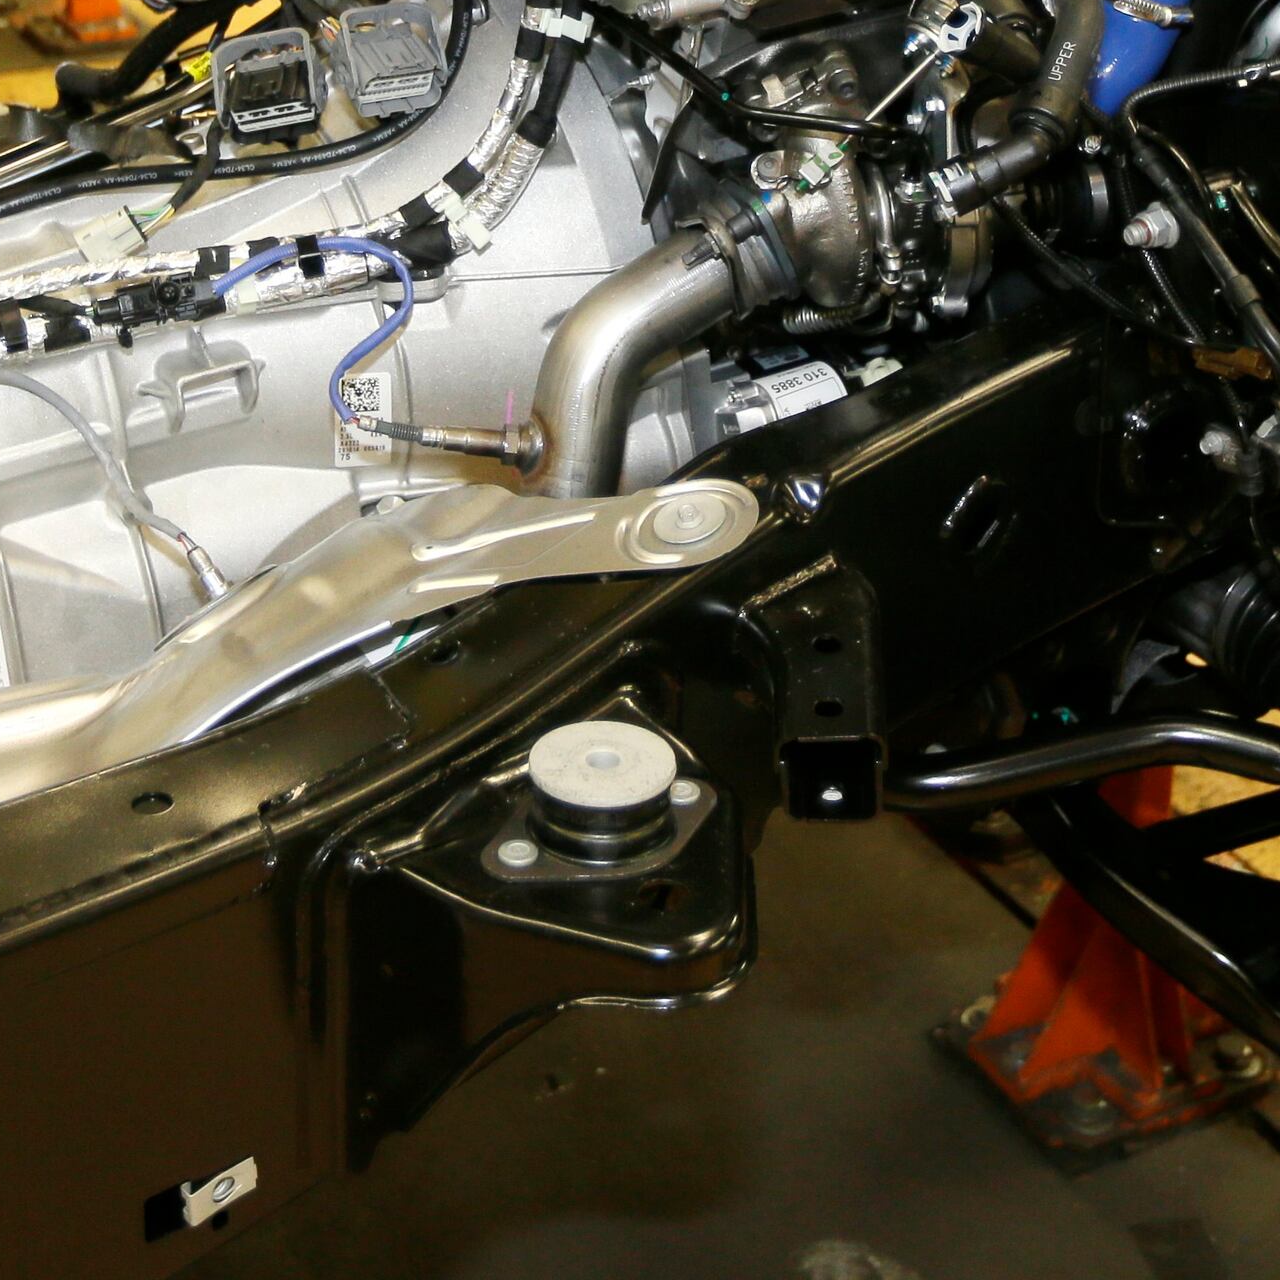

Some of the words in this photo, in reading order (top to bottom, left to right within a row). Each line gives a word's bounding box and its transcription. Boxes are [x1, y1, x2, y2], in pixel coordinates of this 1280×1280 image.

[1047, 41, 1077, 81] UPPER
[803, 368, 828, 382] 310
[771, 376, 803, 393] 3885
